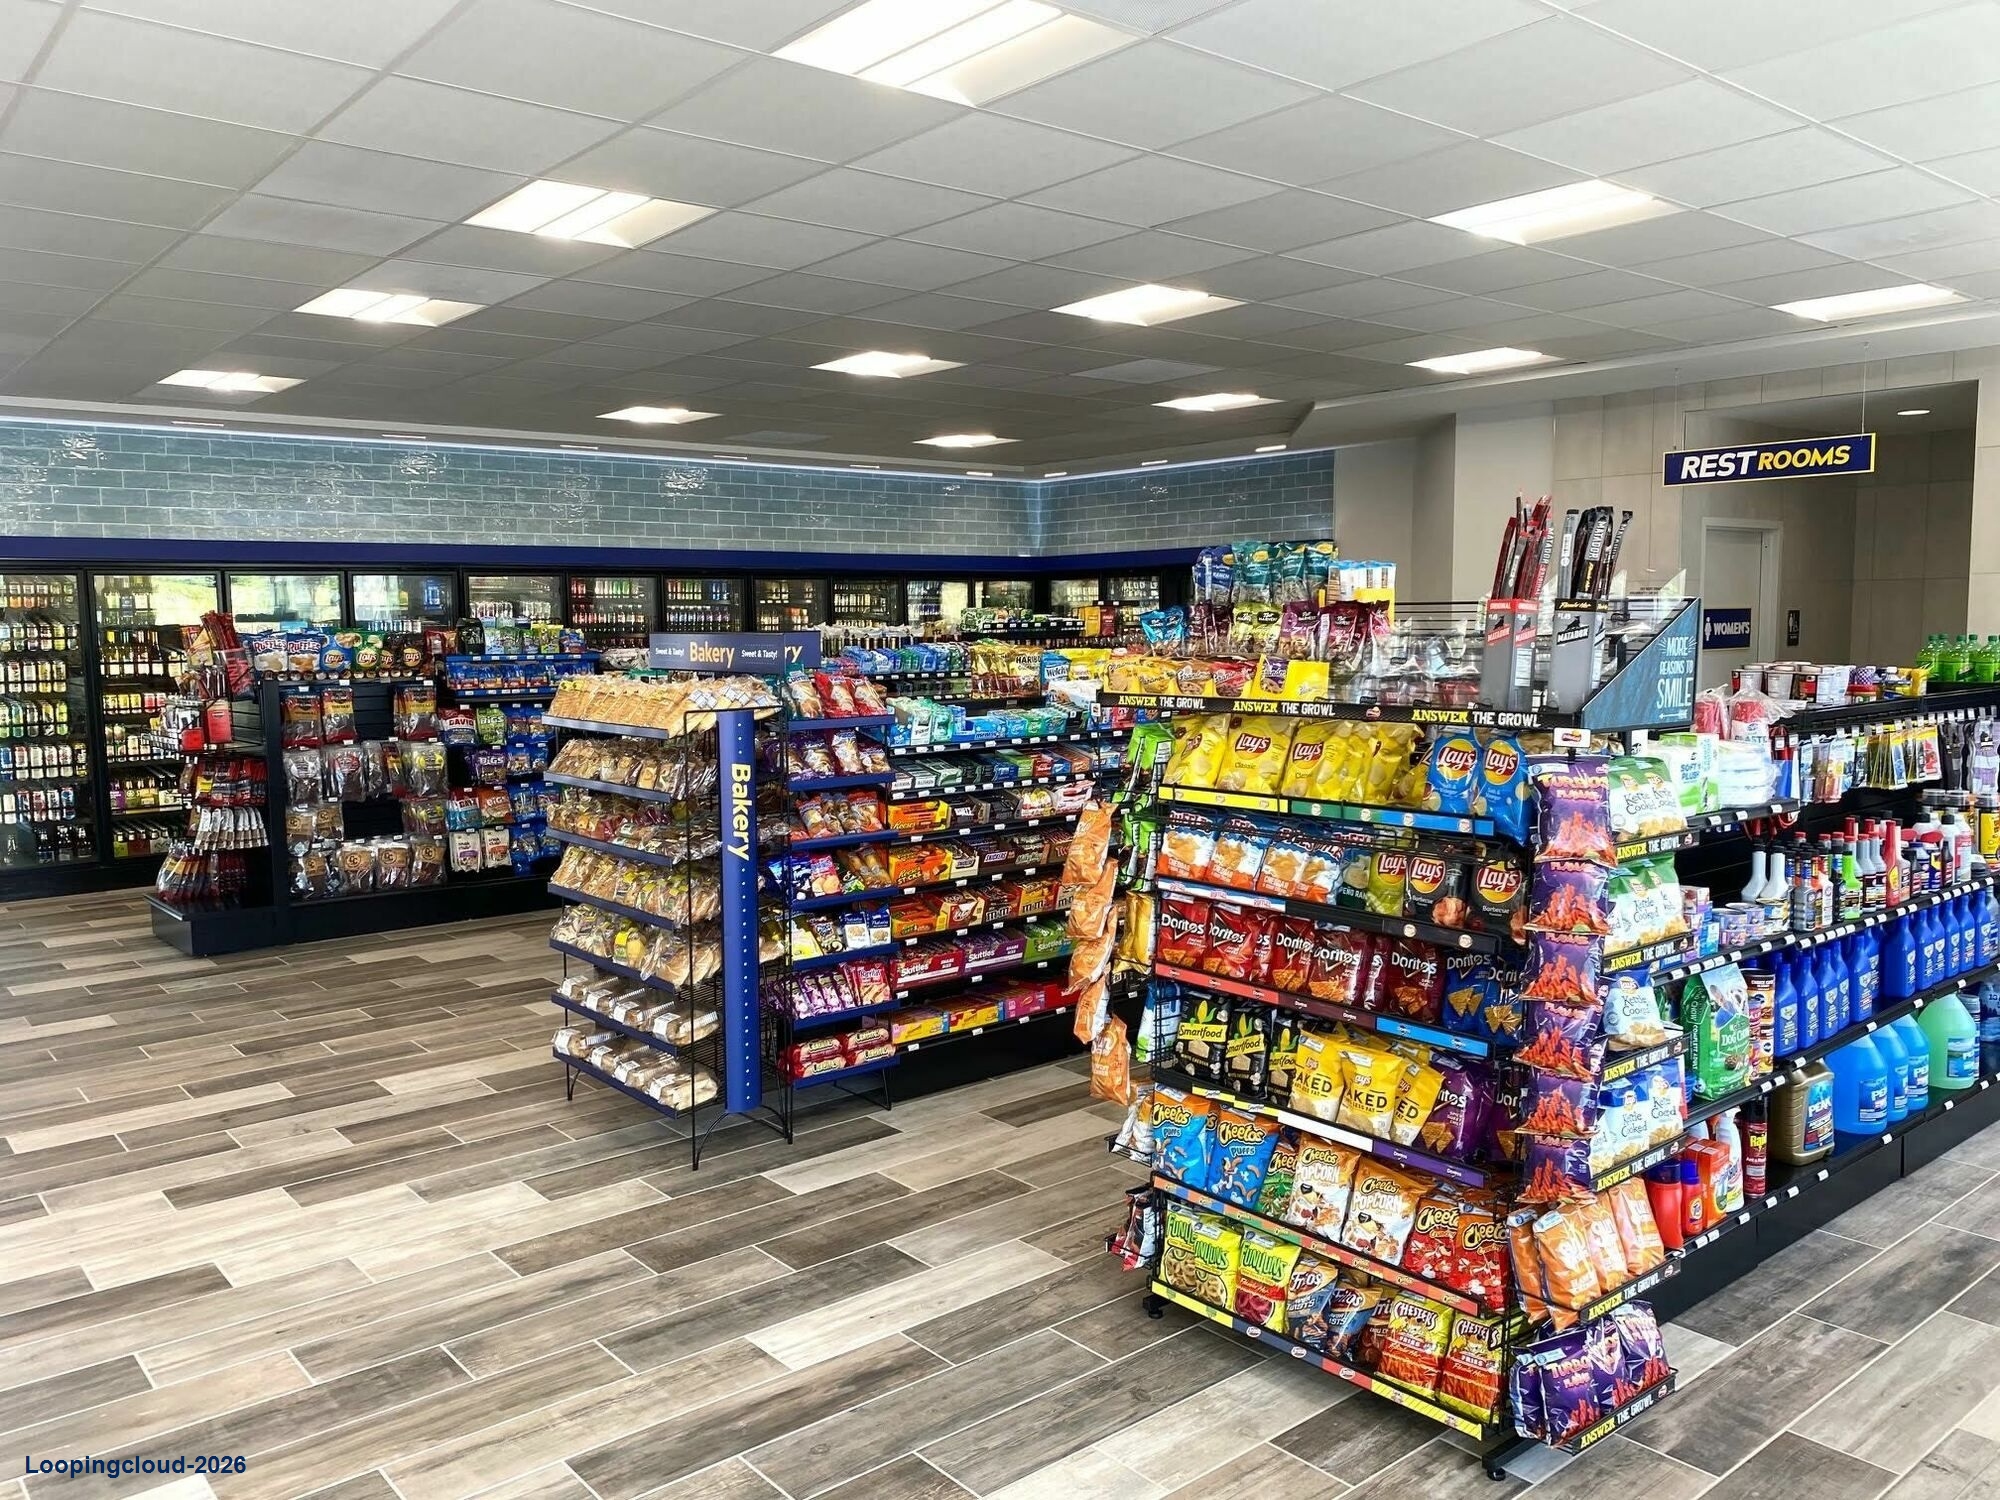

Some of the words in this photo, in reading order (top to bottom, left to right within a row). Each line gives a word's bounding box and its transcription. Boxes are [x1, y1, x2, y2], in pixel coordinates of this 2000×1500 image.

[1680, 451, 1758, 480] REST
[1758, 445, 1851, 471] ROOMS
[1589, 521, 1607, 560] MATADOR
[1557, 627, 1589, 643] MATADOR
[1713, 620, 1750, 636] WOMEN'S
[253, 640, 287, 652] RUFFLES
[288, 640, 321, 652] RUFFLES
[689, 641, 735, 668] Bakery
[741, 650, 756, 658] Sweet
[763, 650, 778, 659] Tasty!
[1666, 636, 1689, 656] MORE
[1659, 660, 1685, 674] REASONS
[1686, 660, 1694, 674] TO
[1118, 695, 1157, 706] ANSWER
[1159, 696, 1175, 707] THE
[1176, 697, 1206, 709] GROWL
[1657, 678, 1694, 709] SMILE
[1233, 701, 1278, 712] ANSWER
[1281, 702, 1299, 714] THE
[1301, 703, 1336, 716] GROWL
[1411, 709, 1470, 722] ANSWER
[1473, 711, 1494, 724] THE
[1498, 712, 1542, 727] GROWL
[1236, 733, 1271, 754] Lay's
[1293, 742, 1324, 763] Lay's
[1438, 746, 1477, 771] Lay's
[1485, 749, 1517, 775] Lay's
[728, 763, 753, 861] Bakery
[1616, 842, 1647, 859] ANSWER
[1411, 856, 1442, 883] Lay's
[1479, 867, 1520, 893] Lay's
[1355, 891, 1368, 900] RAN
[1482, 904, 1510, 914] Barbecue
[1161, 913, 1205, 935] Doritos
[1276, 932, 1314, 953] Dorito
[969, 949, 995, 962] Skittles
[1391, 950, 1438, 974] Doritos
[1447, 951, 1491, 970] Doritos
[1611, 952, 1642, 971] ANSWER
[900, 962, 930, 977] Skittles
[1178, 1024, 1223, 1041] Smartfood
[1721, 1032, 1737, 1046] DOG
[1603, 1060, 1636, 1082] ANSWER
[1153, 1103, 1191, 1126] Cheetos
[1162, 1127, 1182, 1138] PUFFS
[1219, 1121, 1266, 1145] Cheetos
[1750, 1133, 1767, 1148] Raid
[1230, 1146, 1256, 1156] PUFFS
[1302, 1148, 1339, 1165] Cheetos
[1296, 1164, 1340, 1182] POPCORN
[1596, 1166, 1631, 1192] ANSWER
[1361, 1177, 1400, 1194] Cheetos
[1353, 1191, 1401, 1212] POPCORN
[1463, 1221, 1510, 1249] Cheeto
[1240, 1241, 1286, 1281] FUNYUNS
[1394, 1300, 1439, 1329] CHESTER'S
[1588, 1293, 1623, 1321] ANSWER
[1399, 1336, 1420, 1348] FRIES
[1456, 1320, 1499, 1350] CHESTE'S
[1461, 1355, 1484, 1367] FRIES
[1580, 1419, 1616, 1449] ANSWER
[1616, 1408, 1630, 1425] THE
[1630, 1394, 1654, 1417] GROWL
